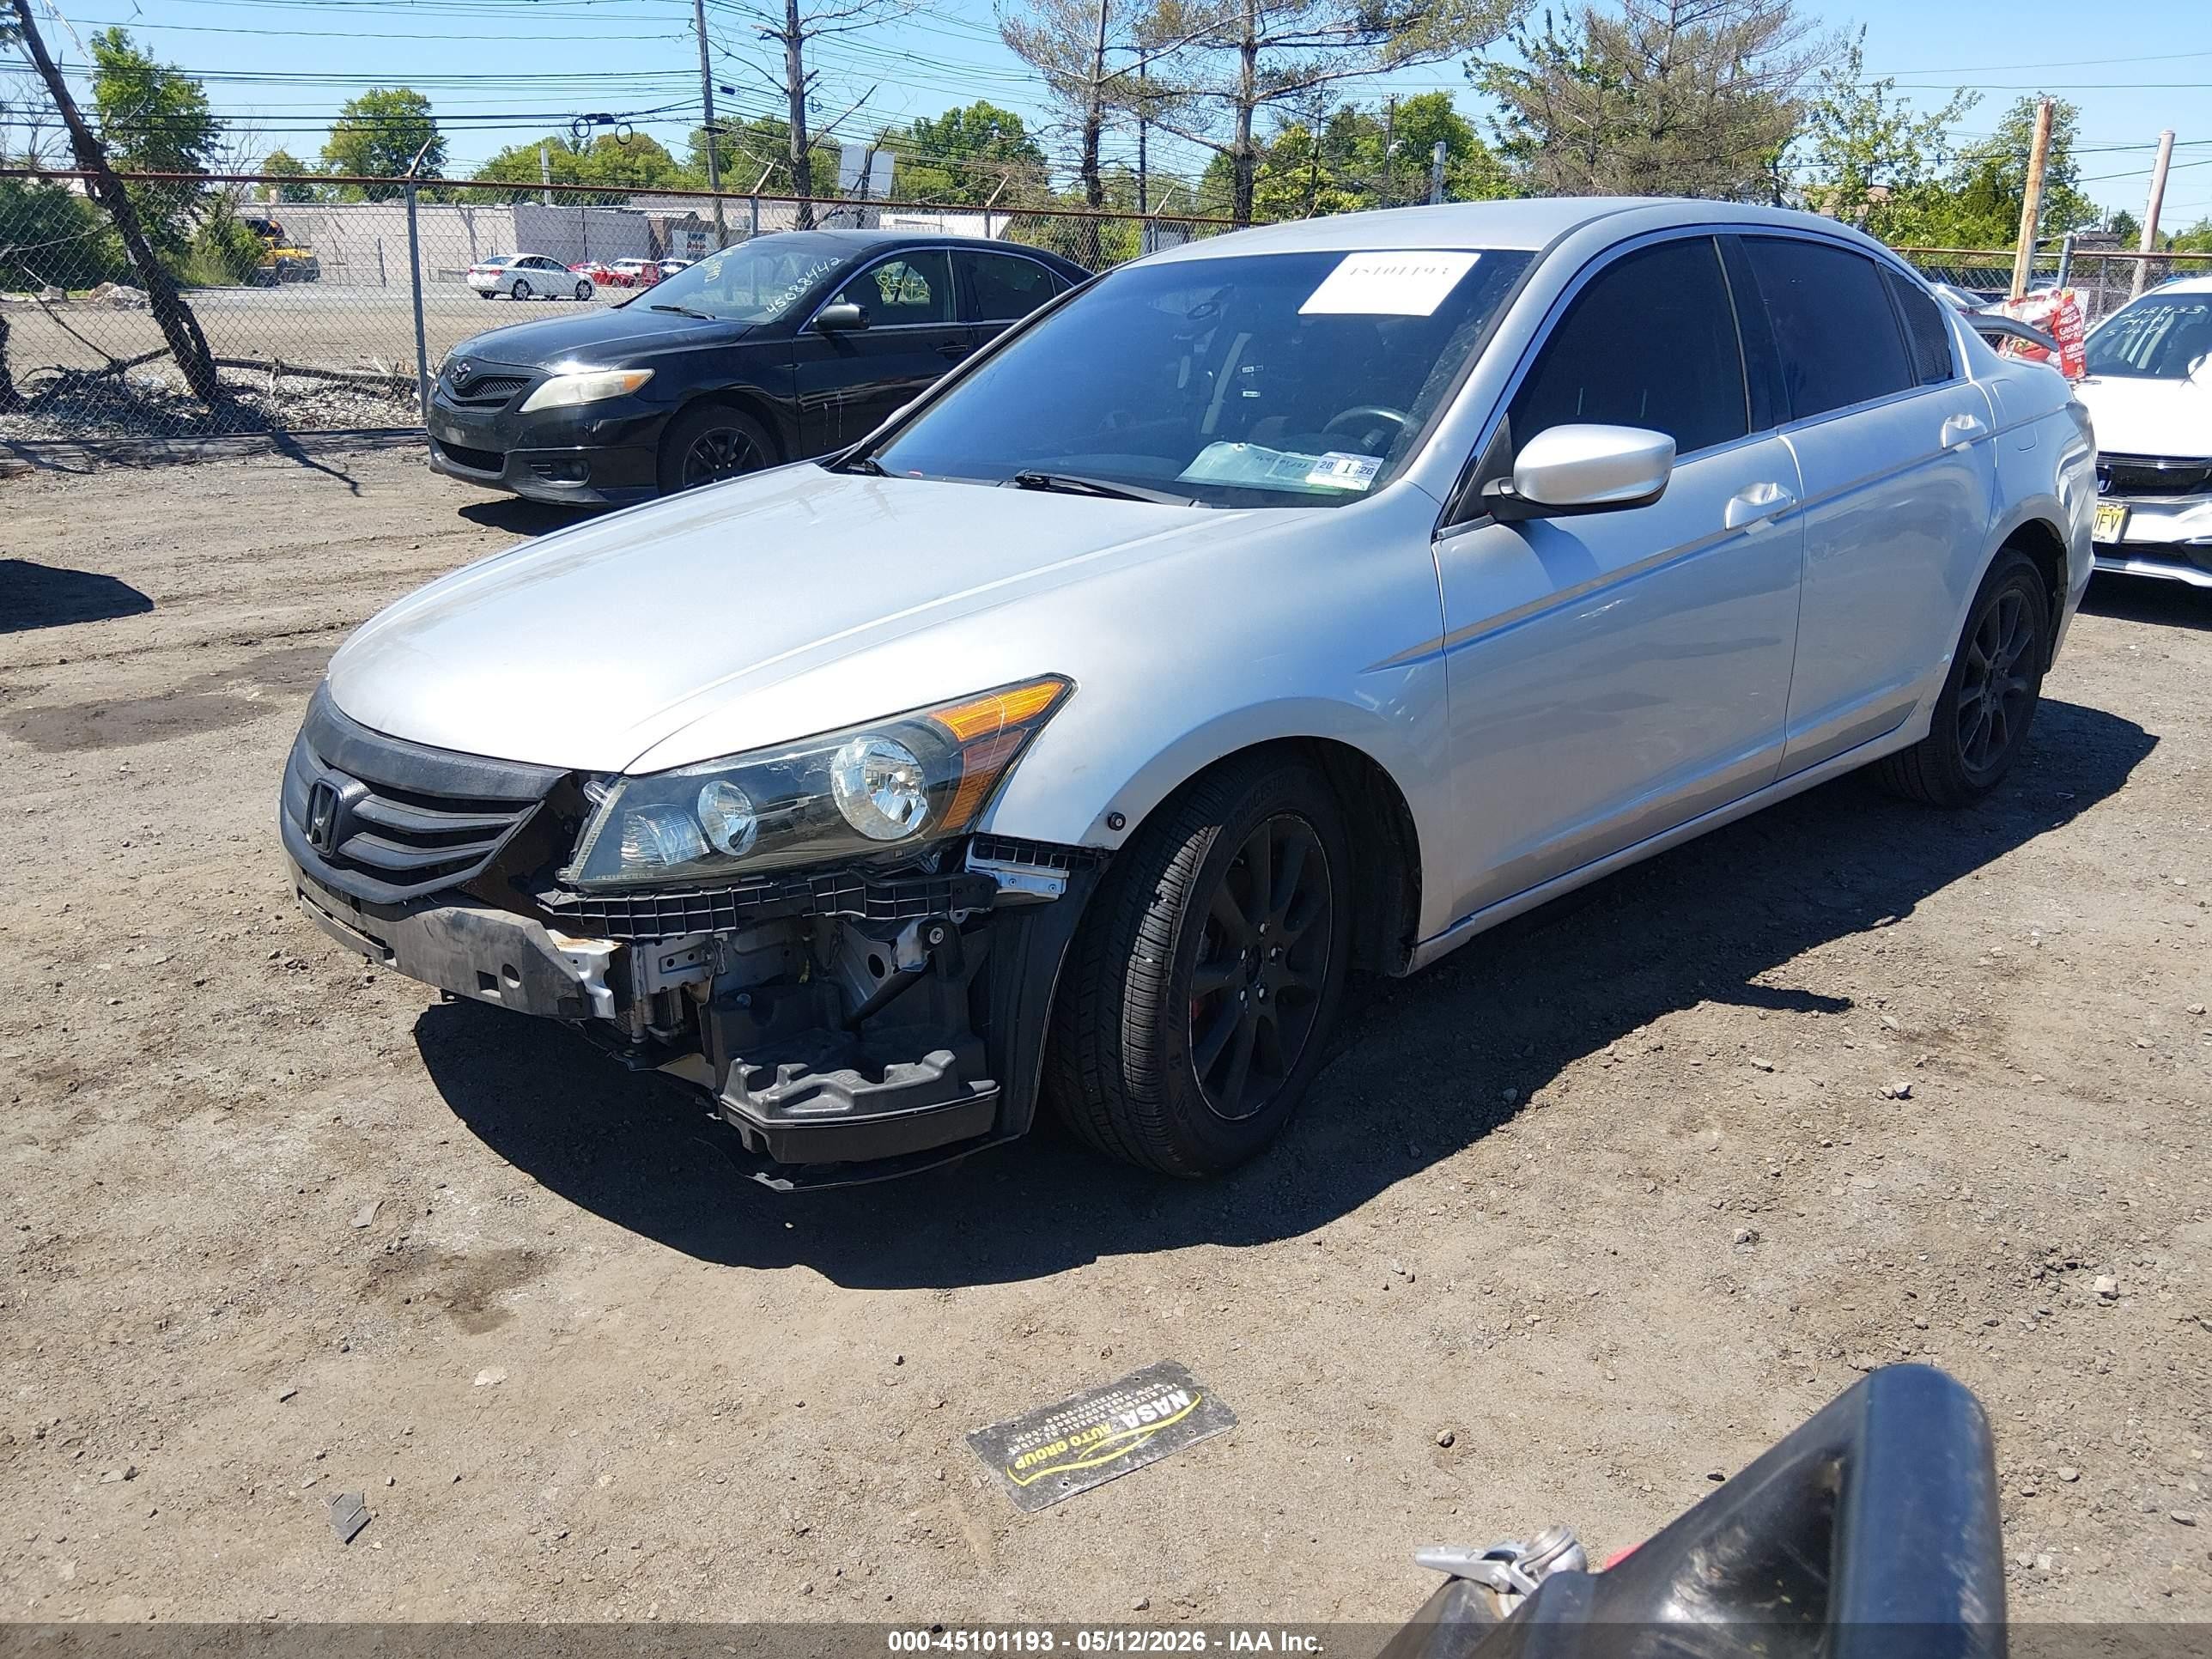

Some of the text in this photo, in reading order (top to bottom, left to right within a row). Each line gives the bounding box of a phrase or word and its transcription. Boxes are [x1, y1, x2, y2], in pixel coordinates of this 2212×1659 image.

[766, 257, 844, 314] 45088442
[1319, 460, 1374, 476] 20 1 26
[1014, 1389, 1191, 1469] NASA AUTO GROUP
[1061, 1412, 1107, 1433] PASSAIC
